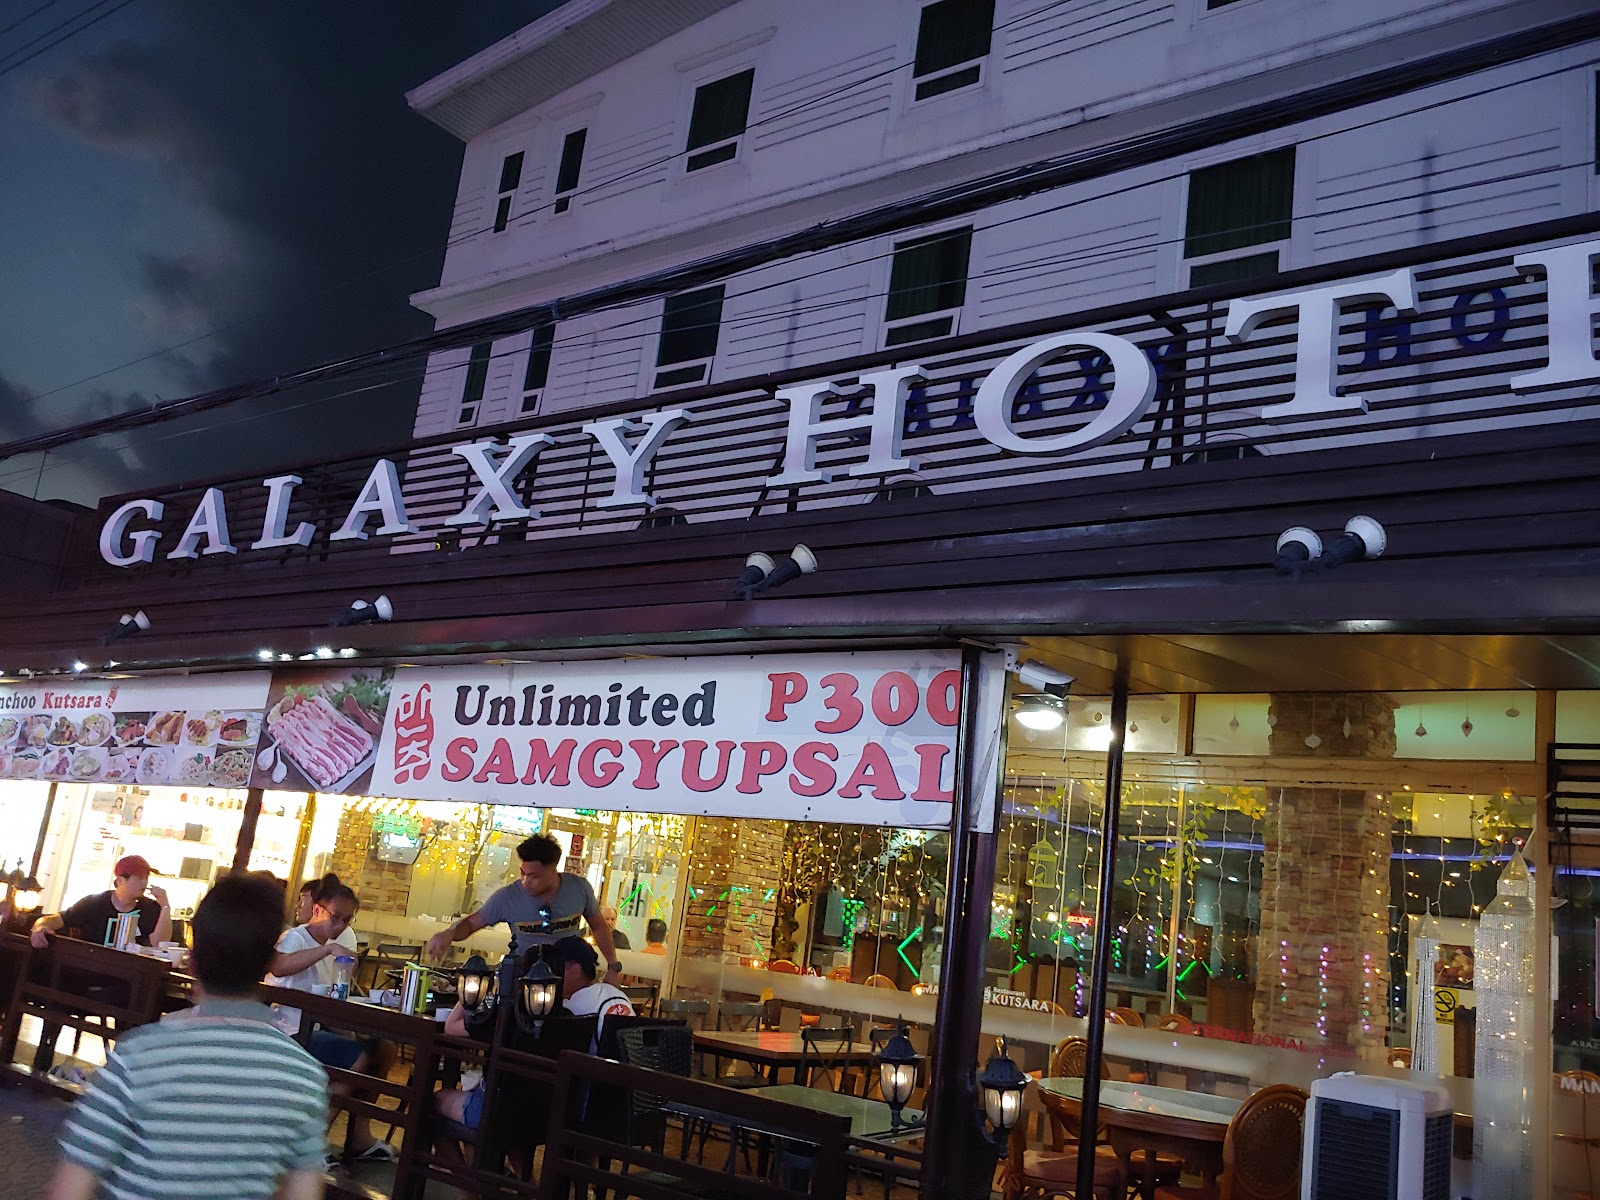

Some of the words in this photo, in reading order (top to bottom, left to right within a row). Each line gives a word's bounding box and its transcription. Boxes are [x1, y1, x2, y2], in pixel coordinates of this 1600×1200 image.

[99, 408, 692, 568] GALAXY
[42, 691, 102, 710] Kutsara
[454, 680, 717, 727] Unlimited
[440, 736, 957, 803] SAMGYUPSAL
[991, 993, 1050, 1012] KUTSARA
[992, 986, 1026, 997] Restaurant
